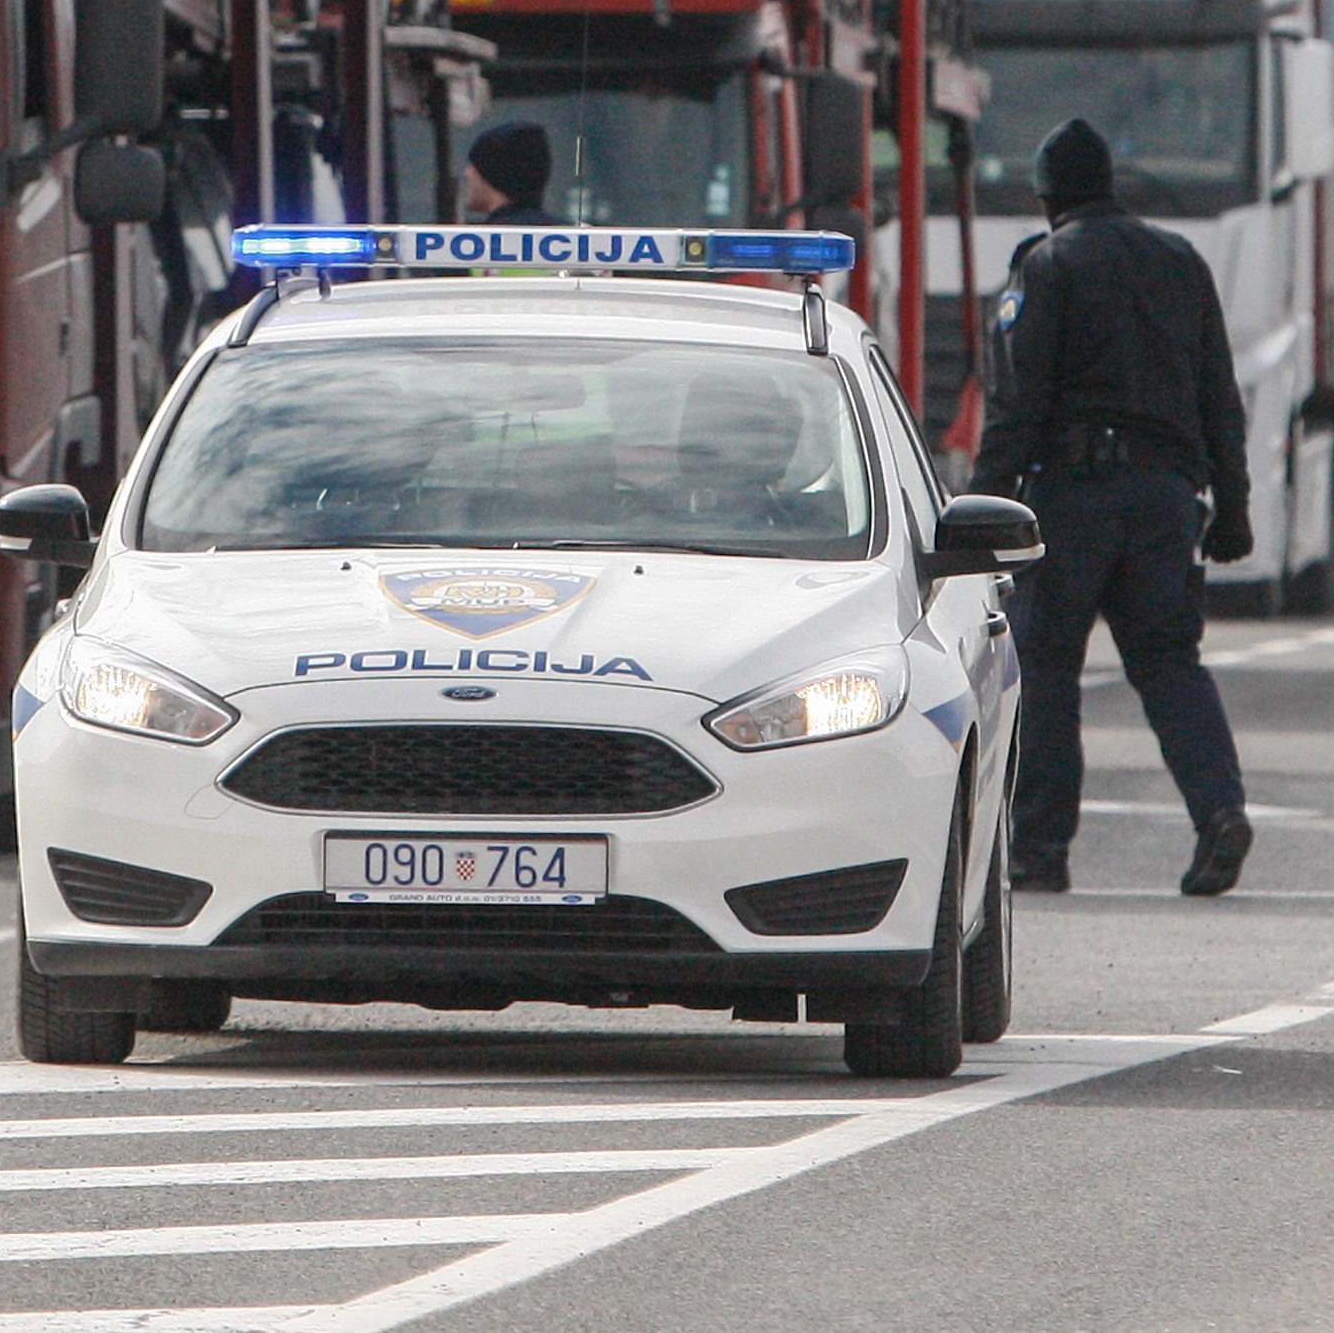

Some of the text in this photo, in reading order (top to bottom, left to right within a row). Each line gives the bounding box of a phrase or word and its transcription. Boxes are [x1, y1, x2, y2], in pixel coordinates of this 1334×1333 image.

[416, 232, 664, 263] POLICIJA
[396, 569, 581, 584] POLICIJA
[294, 649, 654, 682] POLICIJA
[364, 842, 566, 888] 090 764
[426, 894, 453, 902] AUTO
